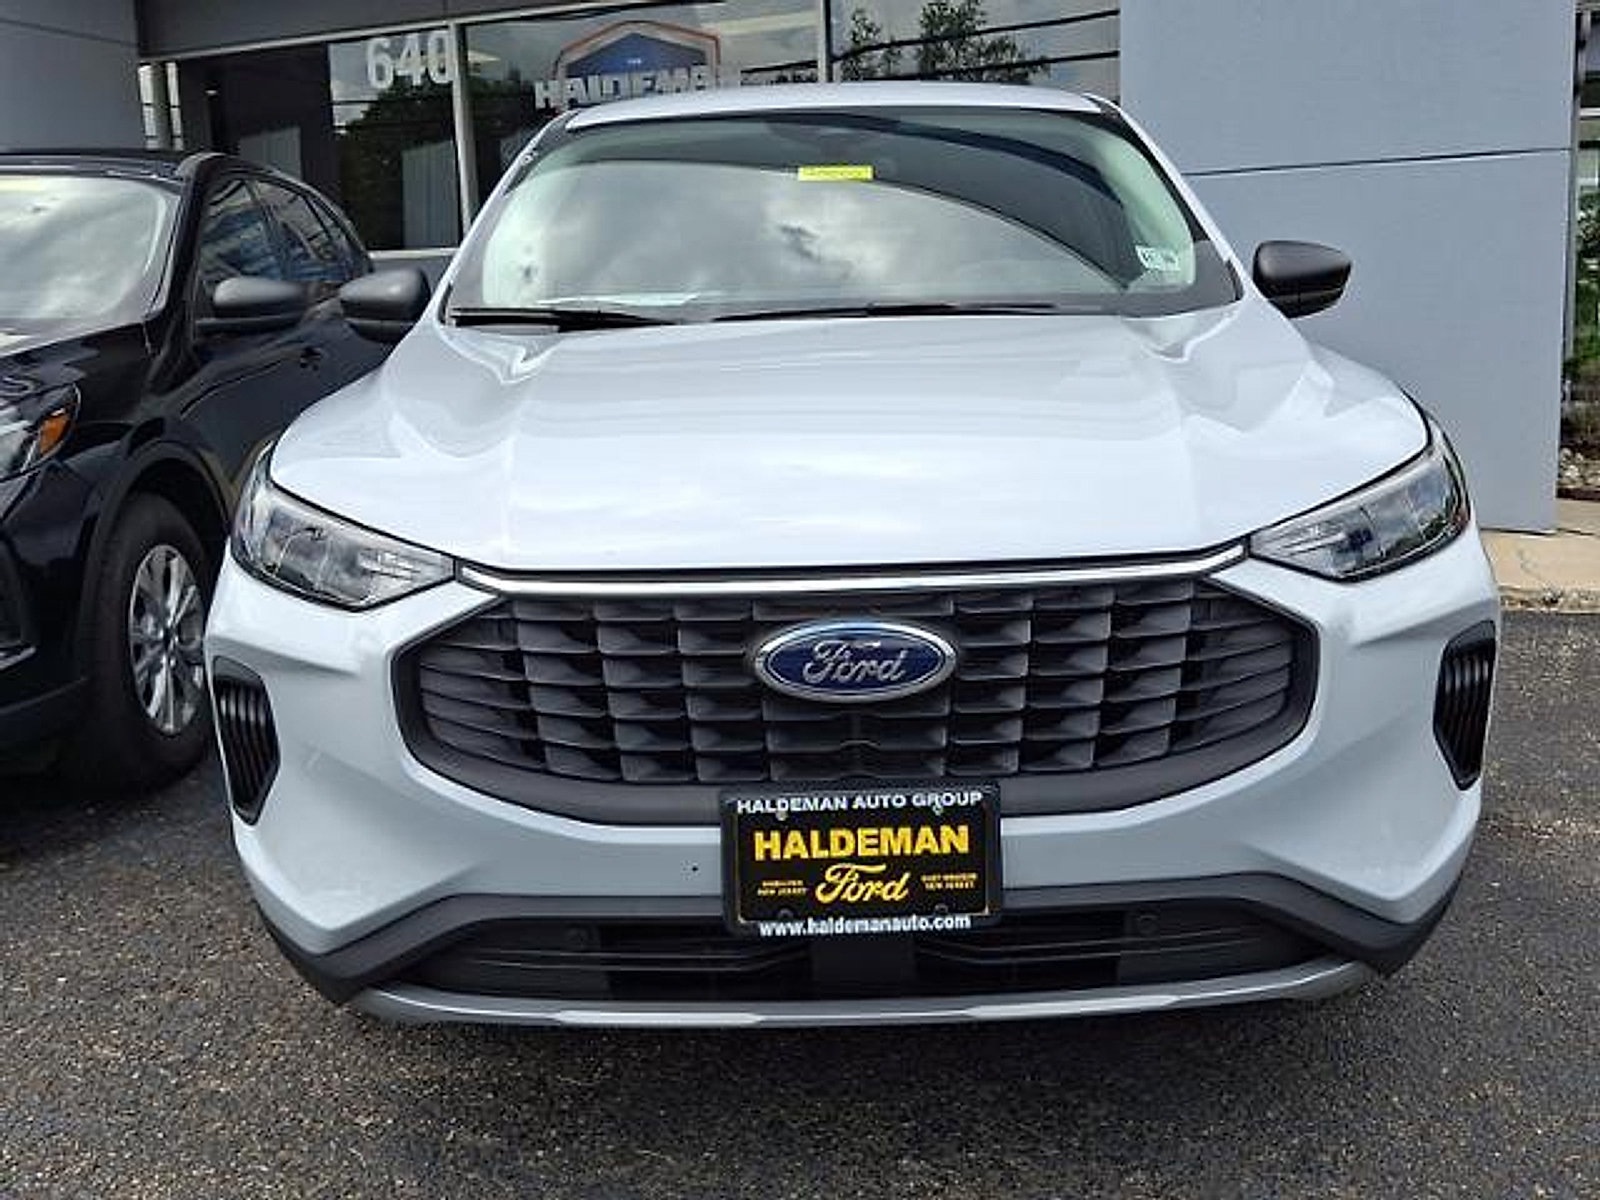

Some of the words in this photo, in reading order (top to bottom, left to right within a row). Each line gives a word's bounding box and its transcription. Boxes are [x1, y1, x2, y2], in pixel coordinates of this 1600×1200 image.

[367, 30, 457, 89] 640
[802, 639, 908, 684] Ford
[736, 796, 848, 814] HALDEMAN
[852, 794, 907, 810] AUTO
[911, 791, 983, 809] GROUP
[754, 825, 970, 861] HALDEMAN
[815, 863, 911, 904] Ford
[759, 914, 971, 936] www.haldemanauto.com
